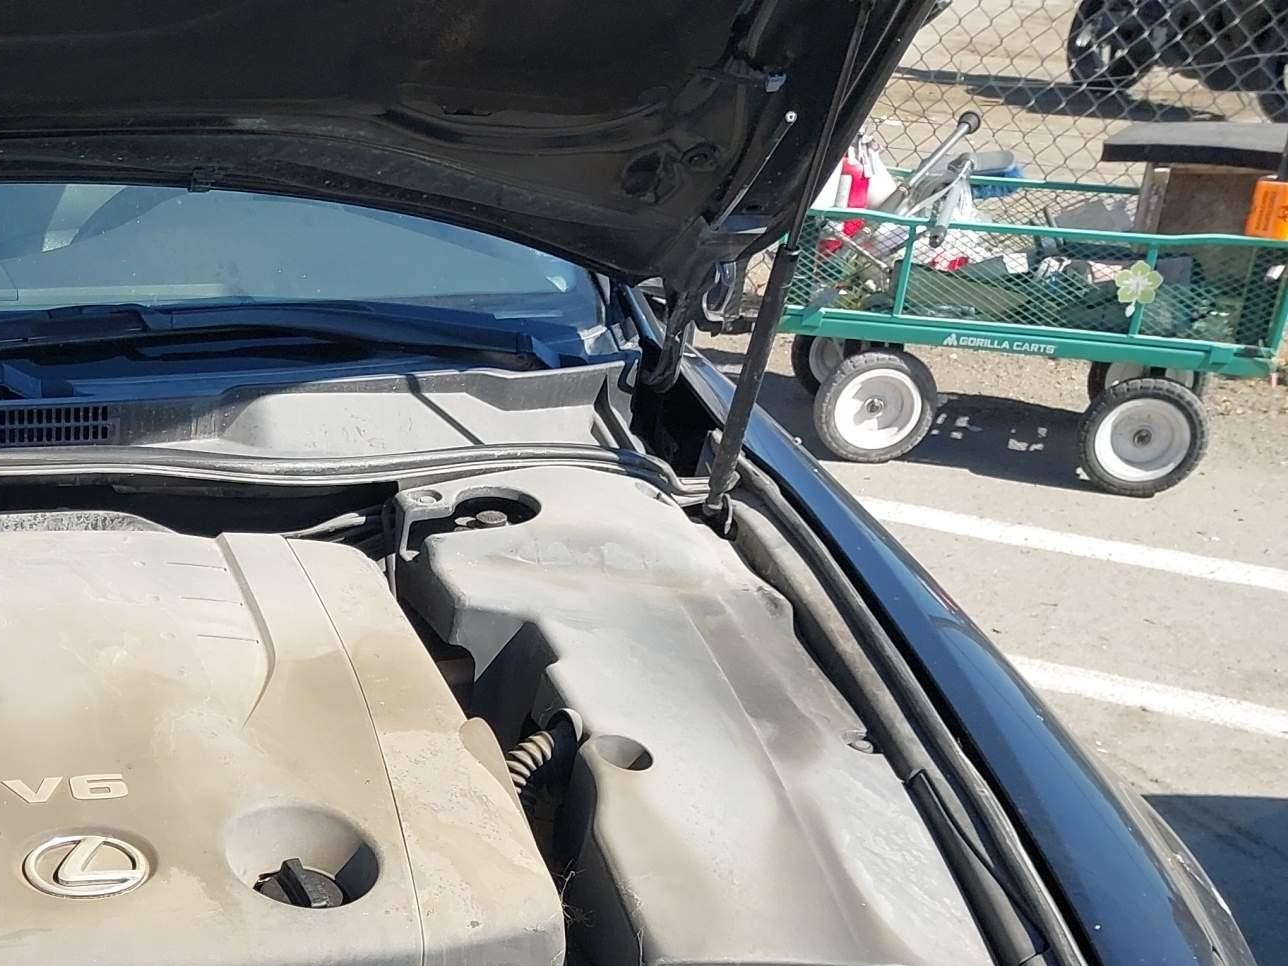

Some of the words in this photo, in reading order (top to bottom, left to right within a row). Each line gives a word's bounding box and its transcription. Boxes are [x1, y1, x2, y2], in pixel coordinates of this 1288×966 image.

[958, 336, 1010, 349] GORILLA
[1012, 341, 1056, 354] CARTS
[0, 772, 129, 804] V6
